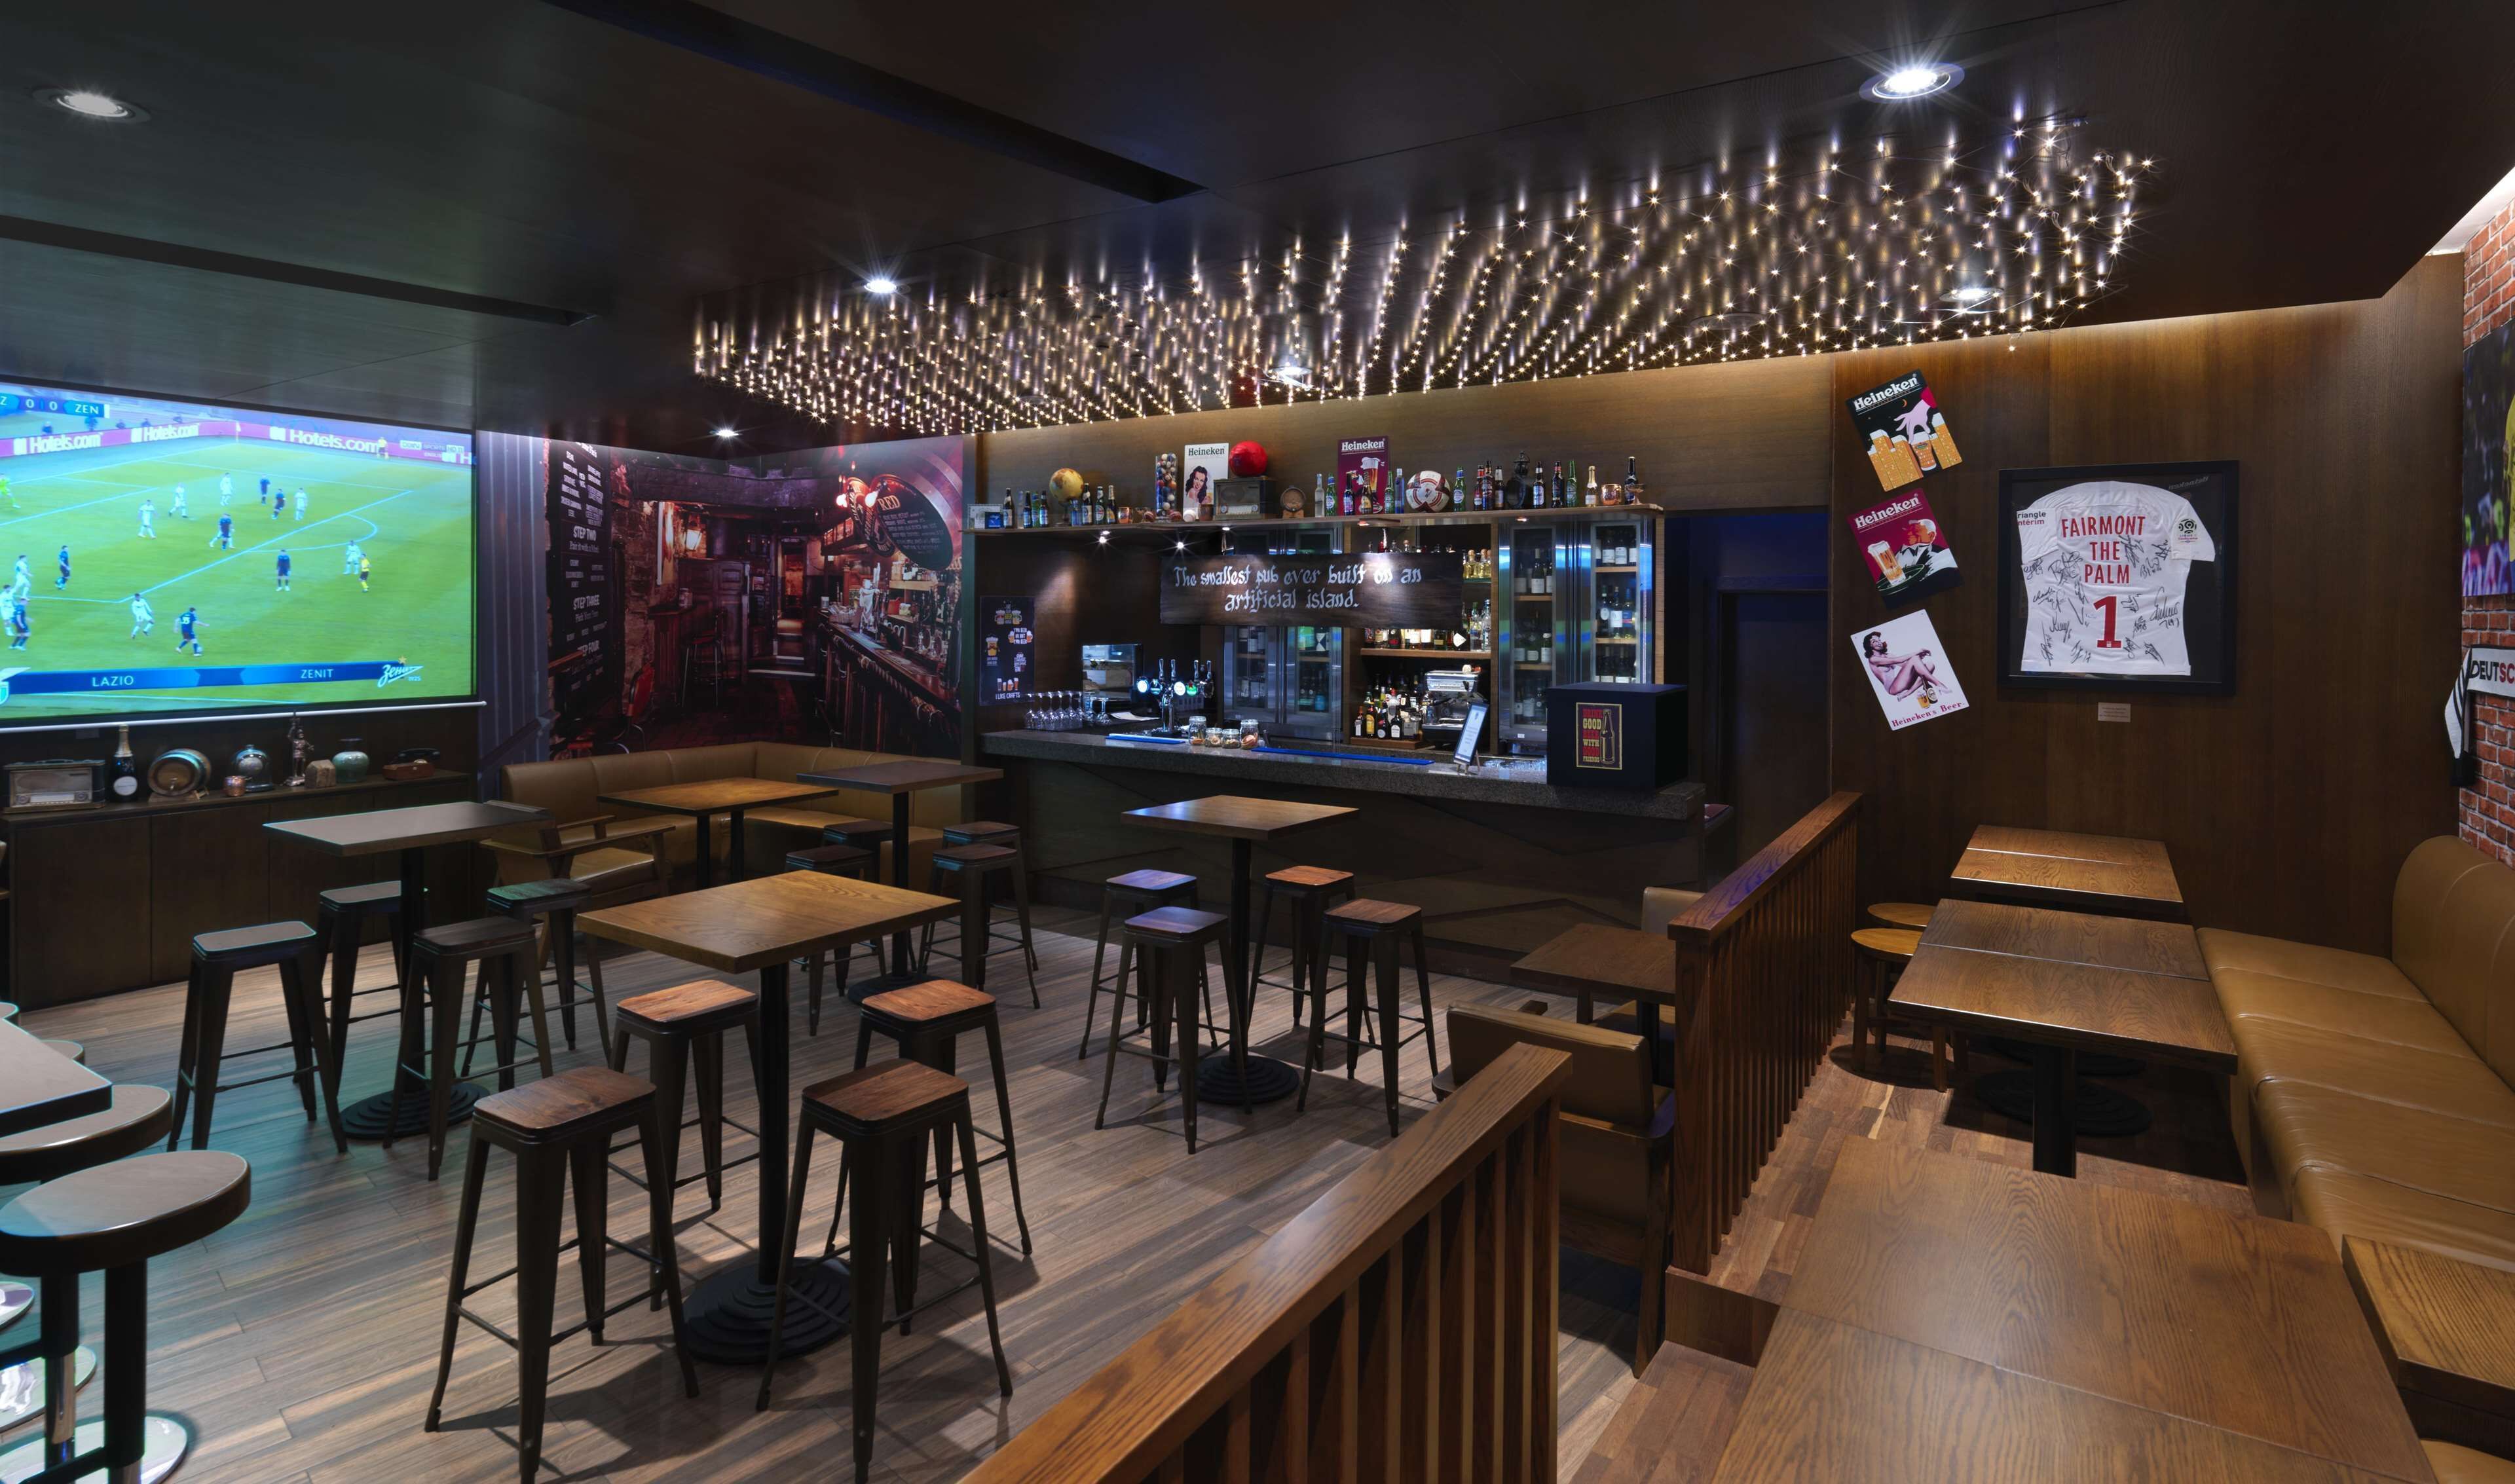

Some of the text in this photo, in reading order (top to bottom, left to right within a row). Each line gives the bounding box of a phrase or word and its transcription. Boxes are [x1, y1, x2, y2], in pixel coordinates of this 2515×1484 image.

[1854, 377, 1920, 411] Heineken
[26, 399, 35, 408] 0
[49, 401, 58, 411] 0
[75, 403, 99, 415] ZEN
[29, 433, 102, 454] Hotels.com
[289, 428, 379, 454] Hotels.com
[1341, 439, 1385, 451] Heineken
[1188, 447, 1225, 456] Heineken
[877, 495, 901, 510] RED
[1854, 496, 1921, 529] Heineken
[2017, 511, 2046, 519] riangle
[574, 525, 597, 542] STEP TWO
[2061, 515, 2146, 538] FAIRMONT
[2089, 541, 2120, 561] THE
[1174, 563, 1422, 587] The smallest pub ever built on an
[2084, 564, 2129, 584] PALM
[573, 594, 600, 610] STEP THREE
[1224, 585, 1360, 613] artificial island.
[2093, 595, 2123, 649] 1
[301, 669, 335, 678] ZENIT
[2470, 660, 2515, 684] DEUTSC
[92, 675, 134, 687] LAZIO
[1582, 709, 1603, 718] DRINK
[1891, 710, 1937, 727] Heineken's
[1582, 718, 1602, 730] GOOD
[1582, 730, 1599, 739] BEER
[1582, 747, 1600, 756] GOOD
